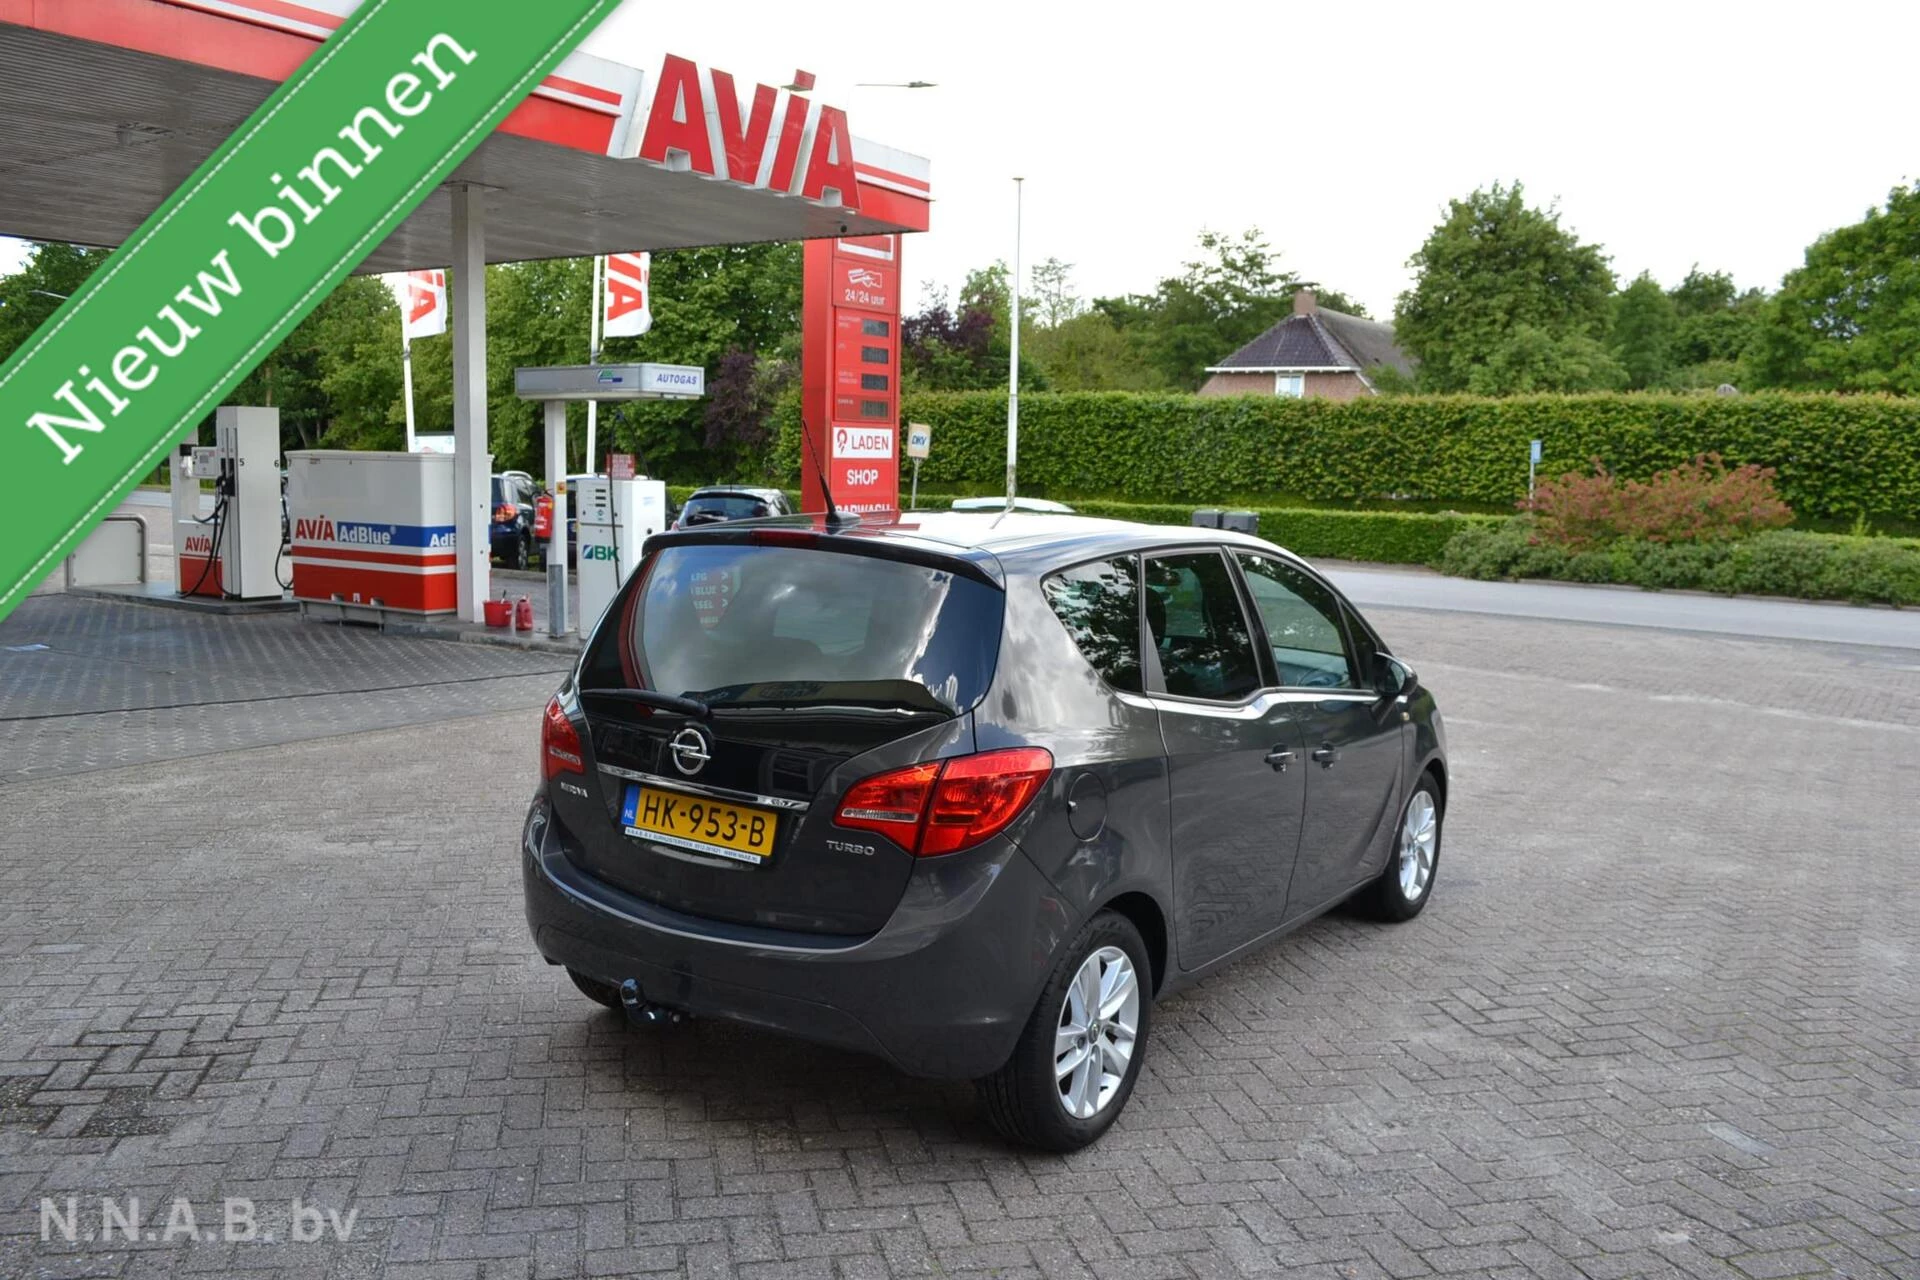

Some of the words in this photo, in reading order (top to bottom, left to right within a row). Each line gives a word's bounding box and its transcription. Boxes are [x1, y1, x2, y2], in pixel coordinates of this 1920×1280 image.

[639, 53, 861, 210] AVIA
[845, 288, 869, 303] 24/24
[656, 374, 697, 385] AUTOGAS
[852, 435, 889, 450] LADEN
[912, 435, 927, 445] DKV
[239, 458, 245, 466] 5
[274, 459, 280, 468] 6
[847, 469, 878, 485] SHOP
[296, 515, 335, 541] AVIA
[624, 809, 634, 819] NL
[643, 794, 766, 847] HK-953-B
[826, 840, 875, 856] TURBO
